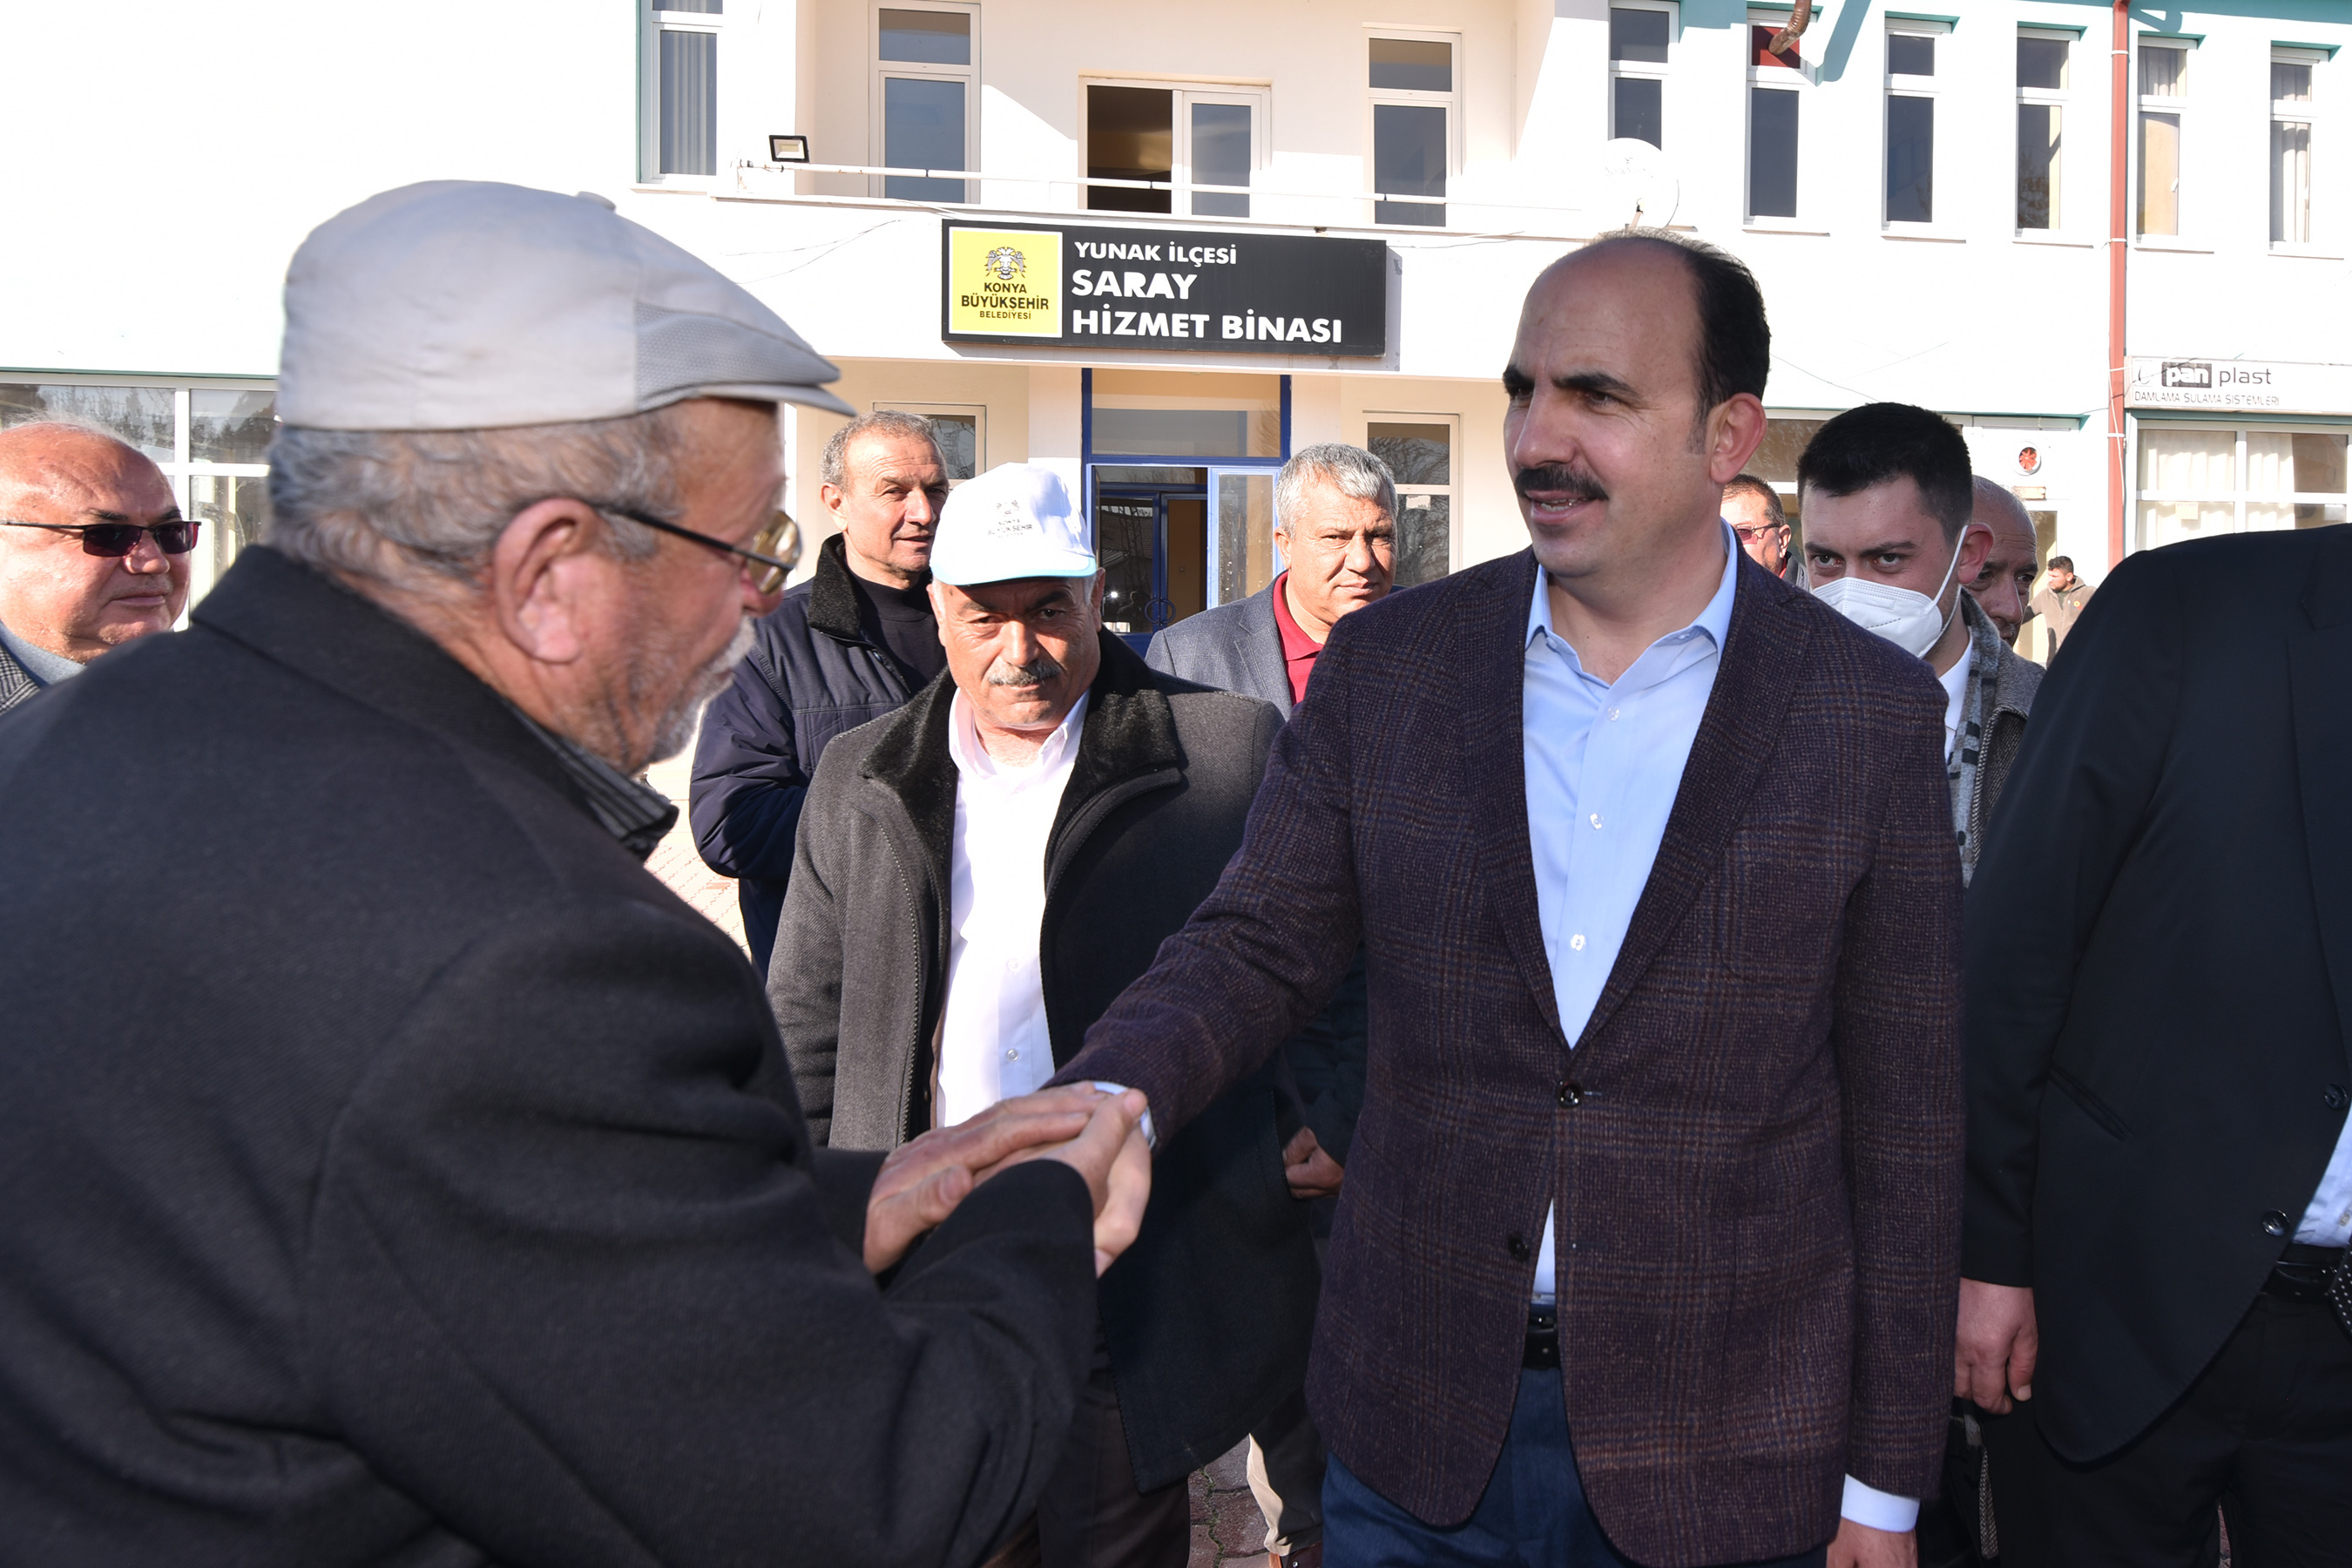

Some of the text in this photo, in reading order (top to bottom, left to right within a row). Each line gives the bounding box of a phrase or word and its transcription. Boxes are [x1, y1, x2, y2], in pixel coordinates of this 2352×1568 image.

[1074, 240, 1237, 268] YUNAK İLÇESİ
[983, 281, 1027, 294] KONYA
[1071, 268, 1198, 300] SARAY
[961, 292, 1049, 312] BÜYÜKŞEHİR
[979, 310, 1031, 320] BELEDİYESİ
[1072, 303, 1342, 343] HİZMET BİNASI
[2166, 366, 2272, 387] pan plast
[2134, 390, 2180, 402] DAMLAMA
[2184, 392, 2222, 403] SULAMA
